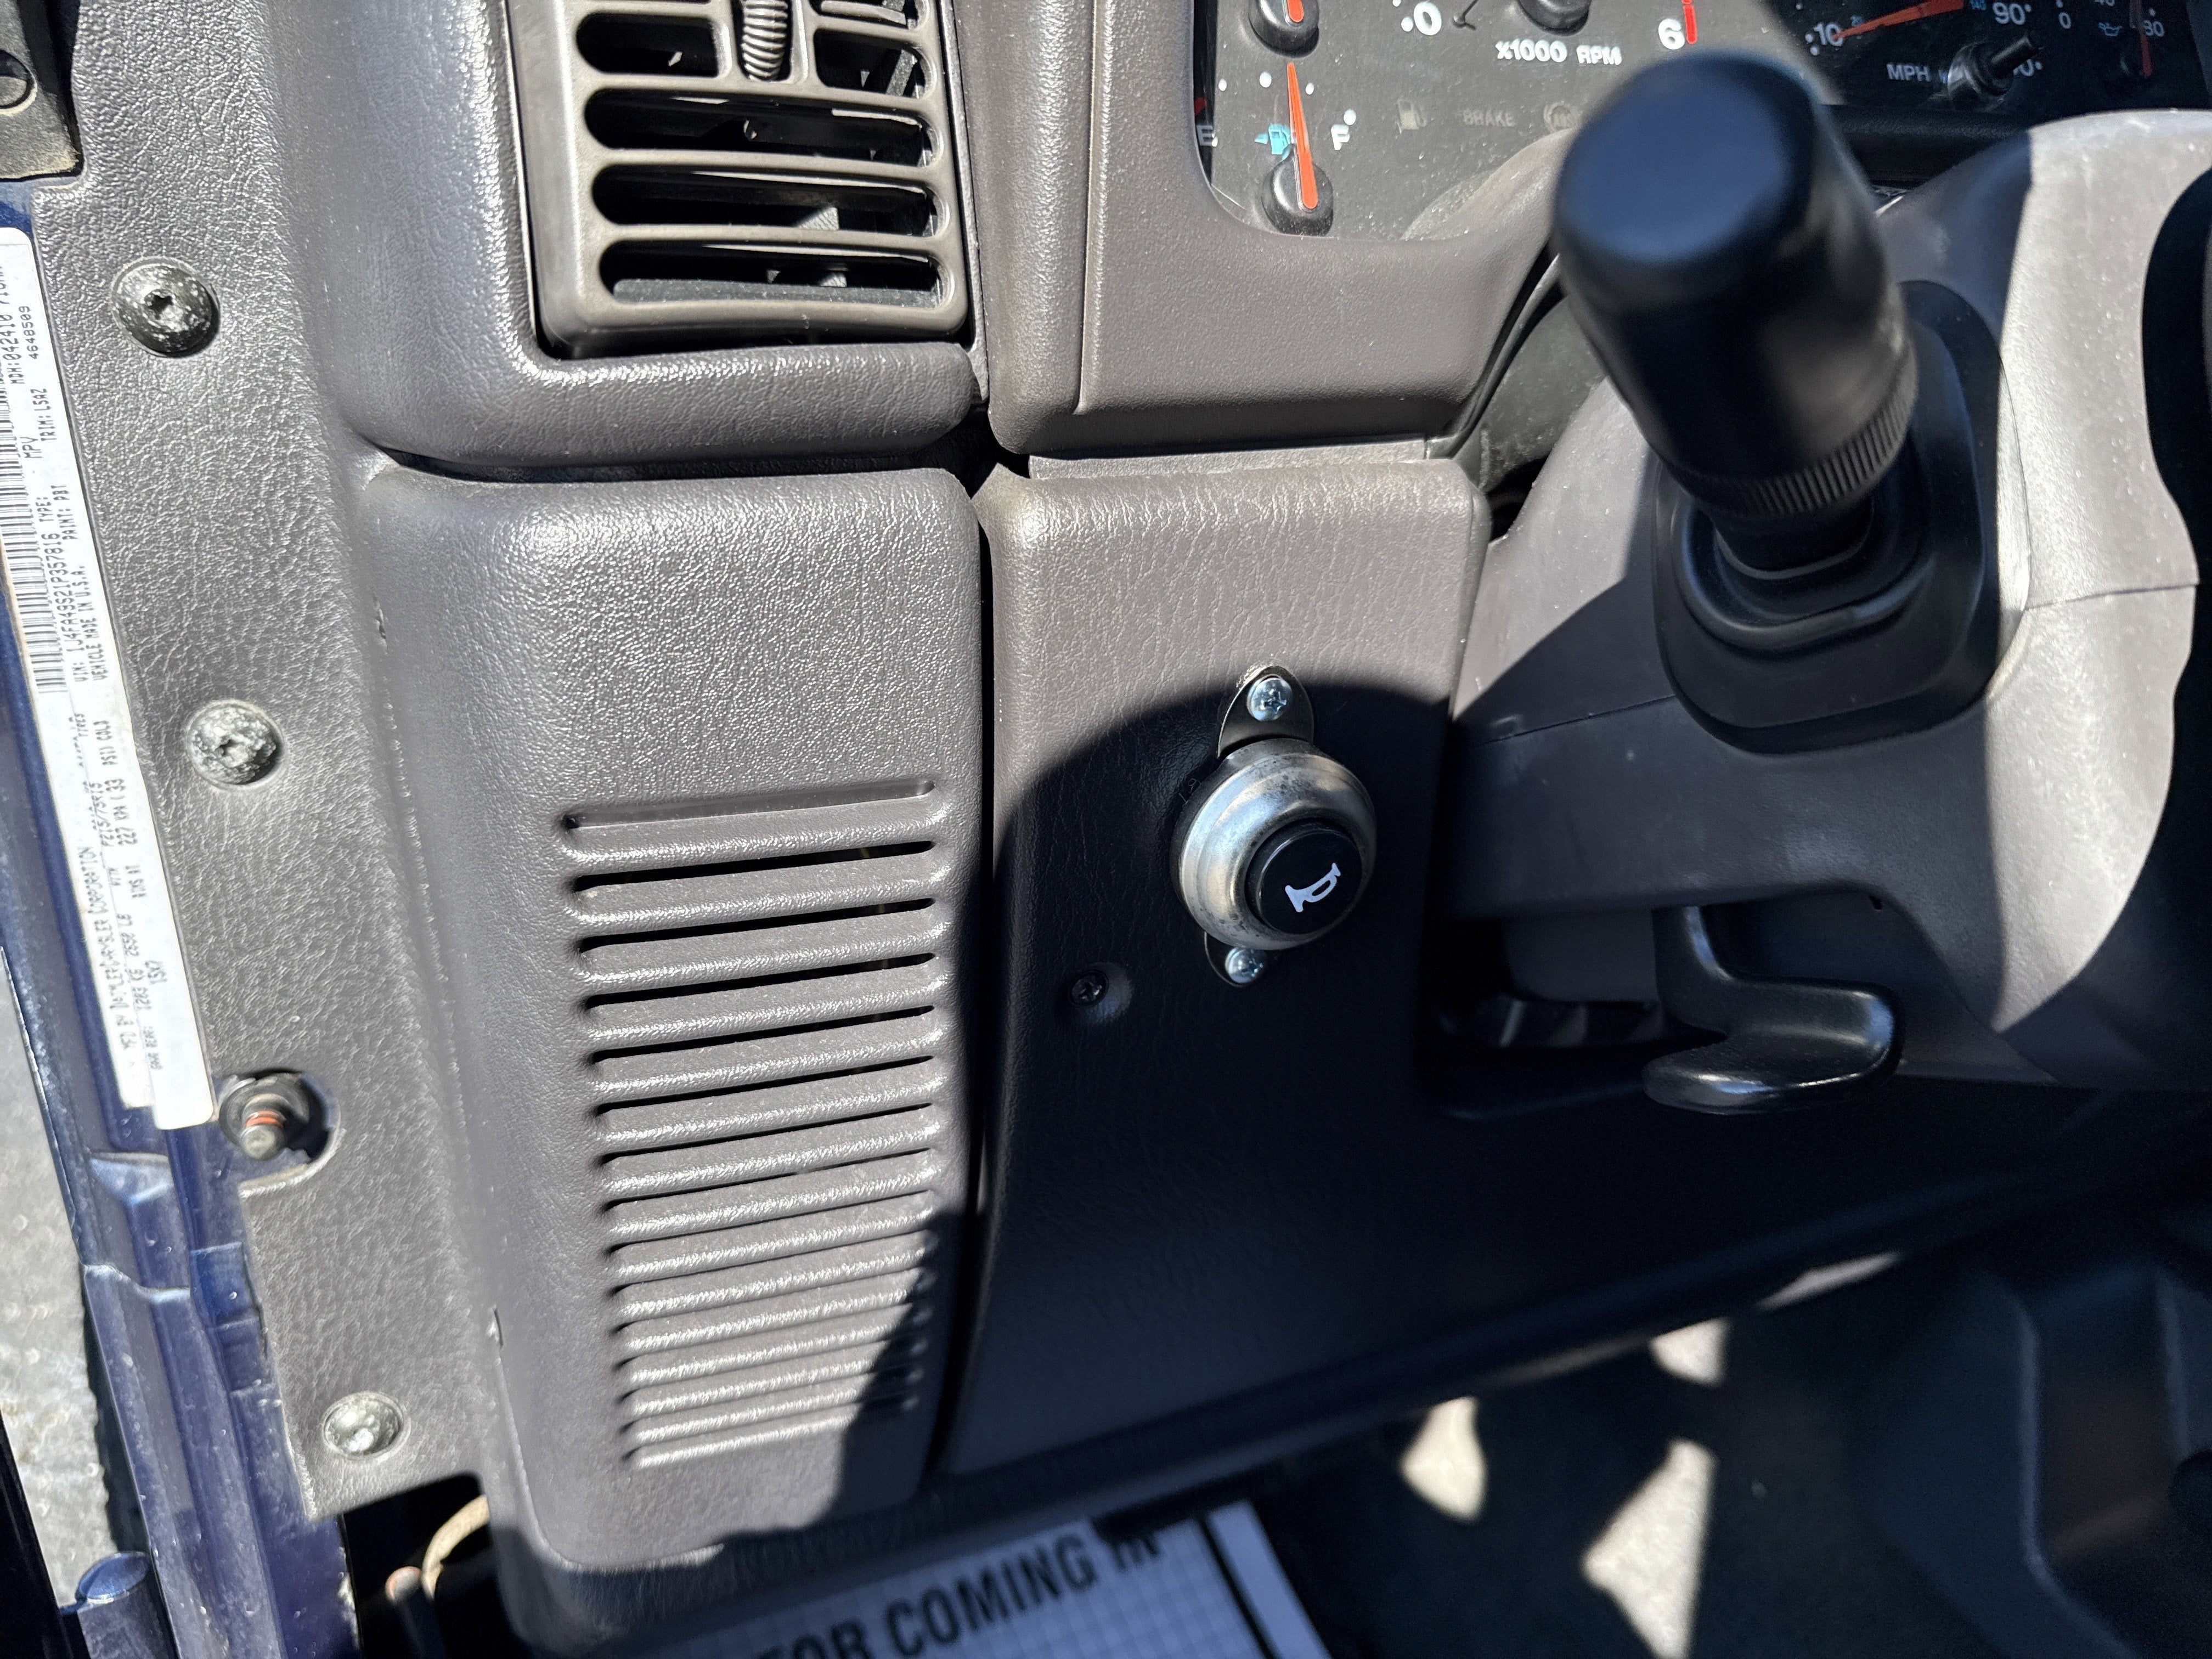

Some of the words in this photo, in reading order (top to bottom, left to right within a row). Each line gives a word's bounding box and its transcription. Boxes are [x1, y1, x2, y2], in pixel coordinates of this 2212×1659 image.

[1414, 2, 1442, 36] 0
[1993, 2, 2026, 25] 90
[2059, 12, 2072, 29] 0
[1658, 19, 1685, 50] 6
[1814, 22, 1844, 47] 10
[1576, 44, 1623, 65] RPM
[1887, 63, 1931, 82] MPH
[1197, 125, 1218, 146] E
[1331, 124, 1350, 150] F
[18, 305, 39, 359] 4648509
[37, 415, 57, 442] TRIM:
[19, 436, 42, 459] MPV
[35, 496, 54, 522] TYPE:
[56, 508, 77, 540] PAINT:
[40, 532, 84, 652] 1J4FA49S21P357816
[70, 565, 91, 597] U.S.A.
[77, 602, 94, 612] IN
[79, 617, 98, 639] MADE
[71, 662, 89, 682] VIN:
[84, 642, 108, 680] VEHICLE
[114, 826, 138, 845] 227
[885, 1533, 1096, 1656] COMING
